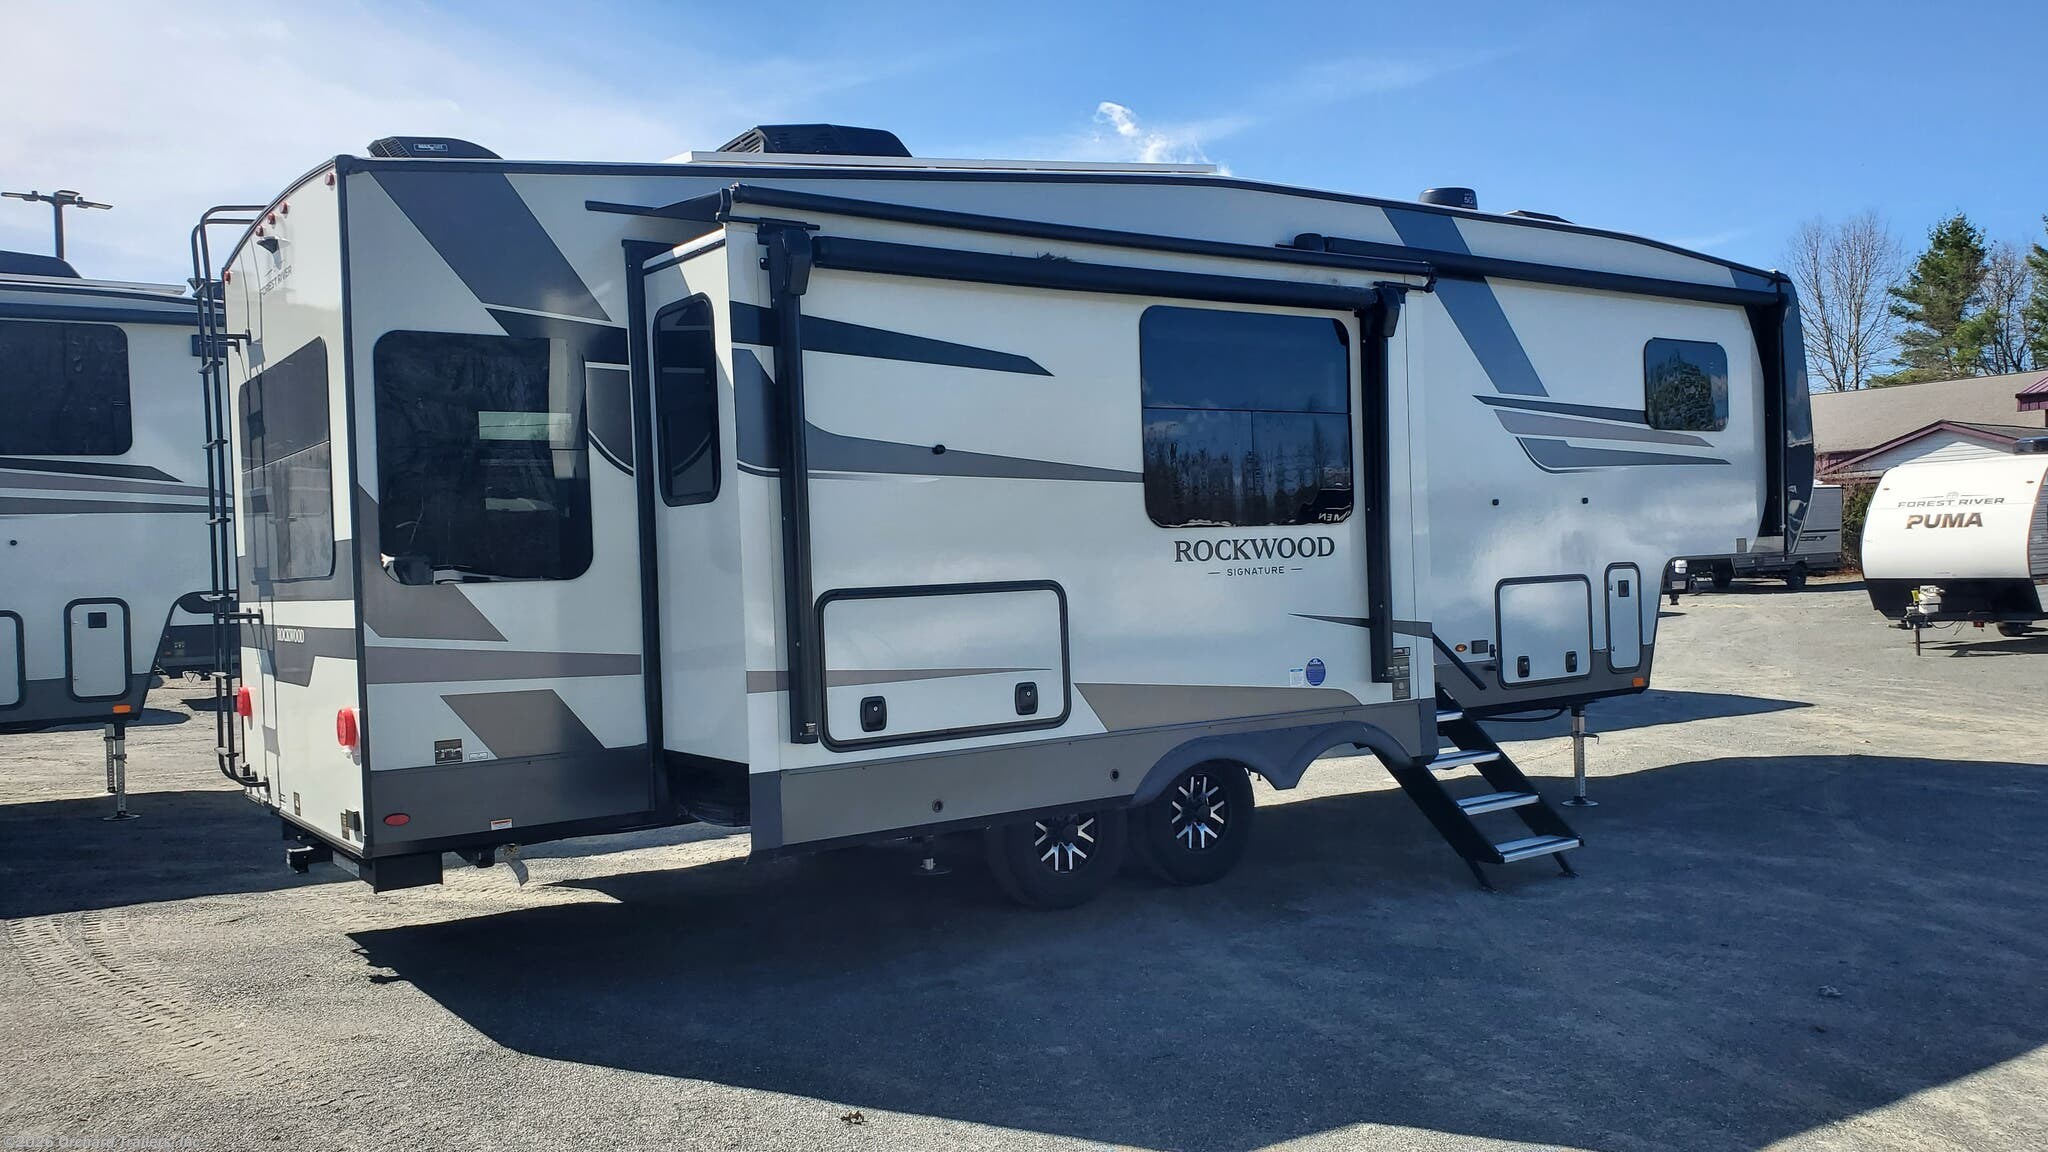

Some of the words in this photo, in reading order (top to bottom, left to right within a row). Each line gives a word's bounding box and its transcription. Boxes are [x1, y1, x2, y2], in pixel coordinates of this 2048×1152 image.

[1898, 499, 1956, 508] FOREST
[1958, 497, 2005, 506] RIVER
[1905, 512, 1983, 529] PUMA
[1174, 536, 1335, 562] ROCKWOOD
[1226, 566, 1285, 577] SIGNATURE
[276, 627, 305, 643] ROCKWOOD
